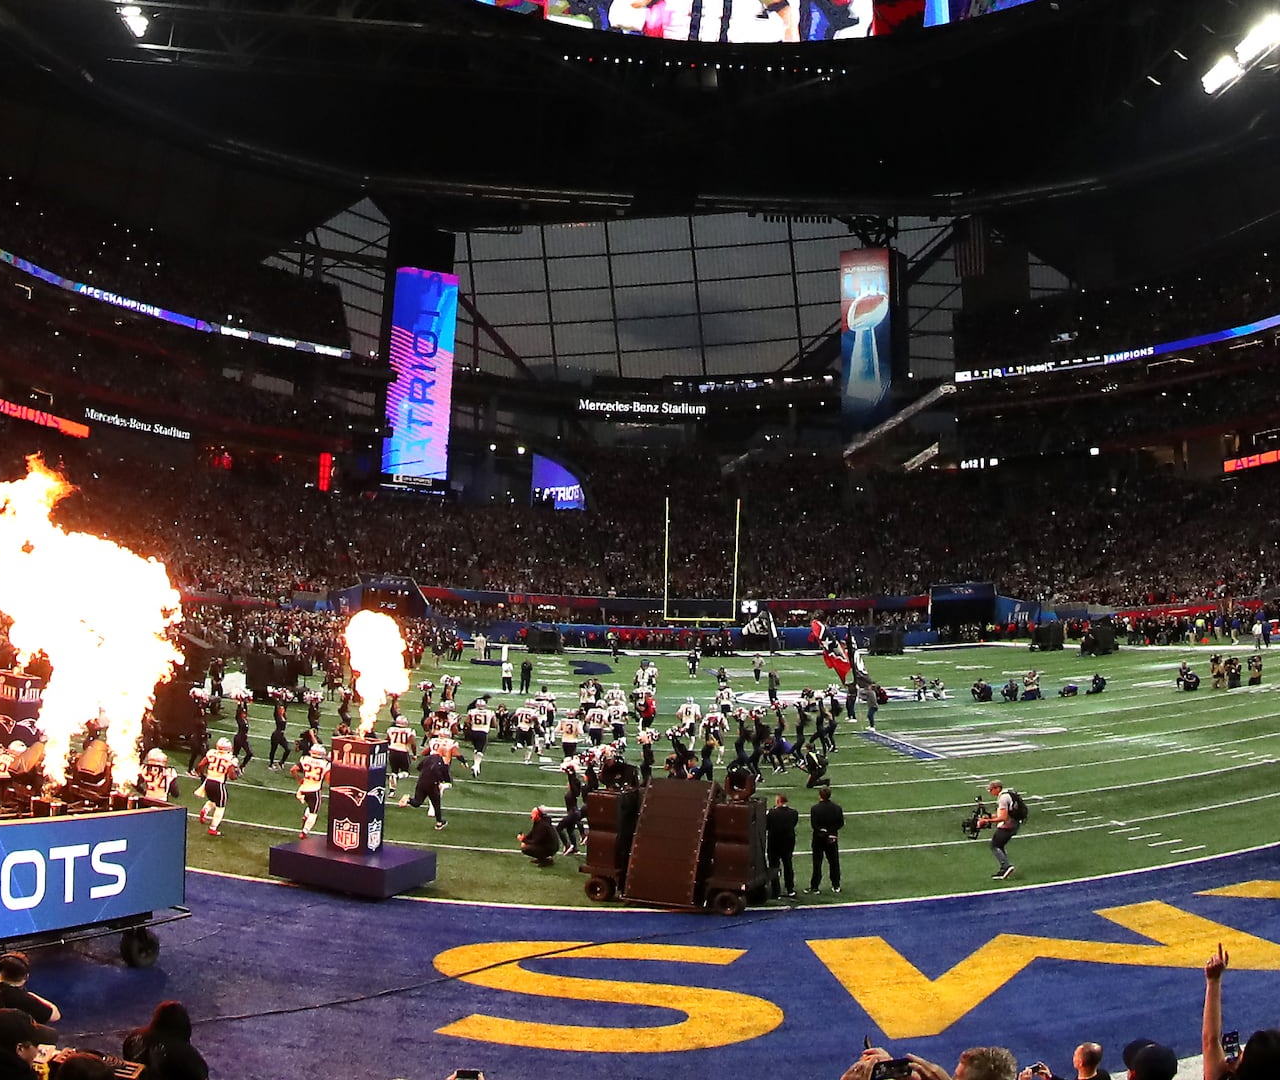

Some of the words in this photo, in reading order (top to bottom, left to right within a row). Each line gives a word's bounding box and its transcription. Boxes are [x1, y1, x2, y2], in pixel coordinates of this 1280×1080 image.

[79, 284, 101, 300] AFC
[102, 292, 161, 317] CHAMPIONS
[1104, 346, 1155, 365] AMPIONS
[578, 398, 660, 414] Mercedes-Benz
[661, 401, 707, 415] Stadium
[84, 407, 152, 433] Mercedes-Benz
[152, 422, 191, 440] Stadium
[473, 713, 487, 725] 61
[388, 731, 409, 744] 70
[207, 756, 226, 774] 26
[304, 763, 322, 782] 23
[336, 832, 356, 846] NFL
